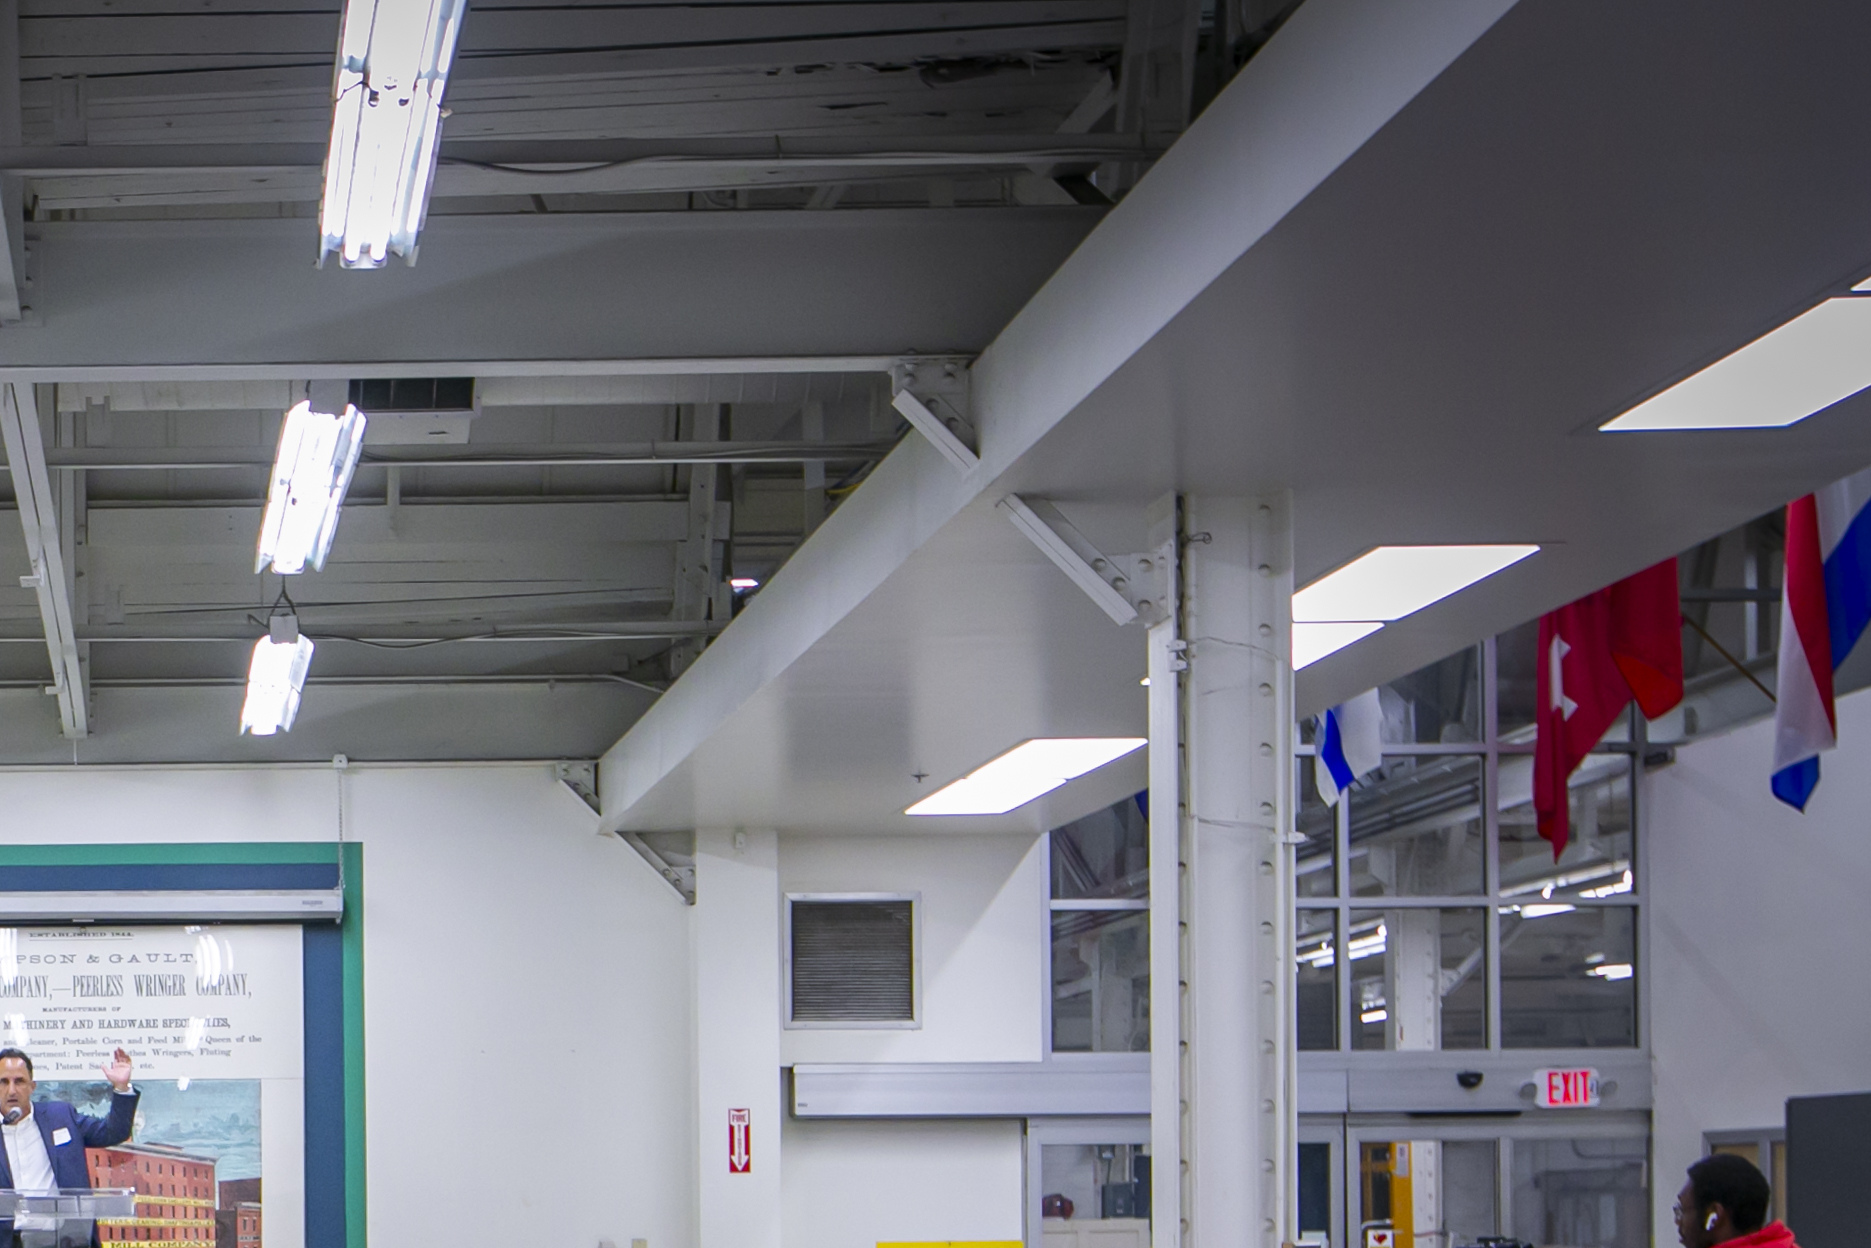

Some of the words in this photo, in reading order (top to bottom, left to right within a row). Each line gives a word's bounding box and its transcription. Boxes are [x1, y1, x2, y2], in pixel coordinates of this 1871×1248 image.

[86, 954, 100, 964] &
[134, 973, 186, 997] WRINGER
[3, 1019, 67, 1030] MHINERY
[71, 1019, 94, 1029] AND
[98, 1019, 159, 1029] HARDWARE
[28, 1037, 58, 1046] leaner,
[62, 1036, 98, 1045] Portable
[102, 1036, 123, 1045] Corn
[127, 1036, 143, 1044] and
[147, 1036, 168, 1044] Feed
[235, 1035, 245, 1043] of
[248, 1035, 262, 1043] the
[75, 1049, 111, 1058] Peerless
[151, 1048, 195, 1058] Wringers,
[199, 1047, 232, 1058] Fluting
[55, 1061, 84, 1070] Patent
[1548, 1070, 1591, 1106] EXIT
[732, 1114, 747, 1123] FIRE
